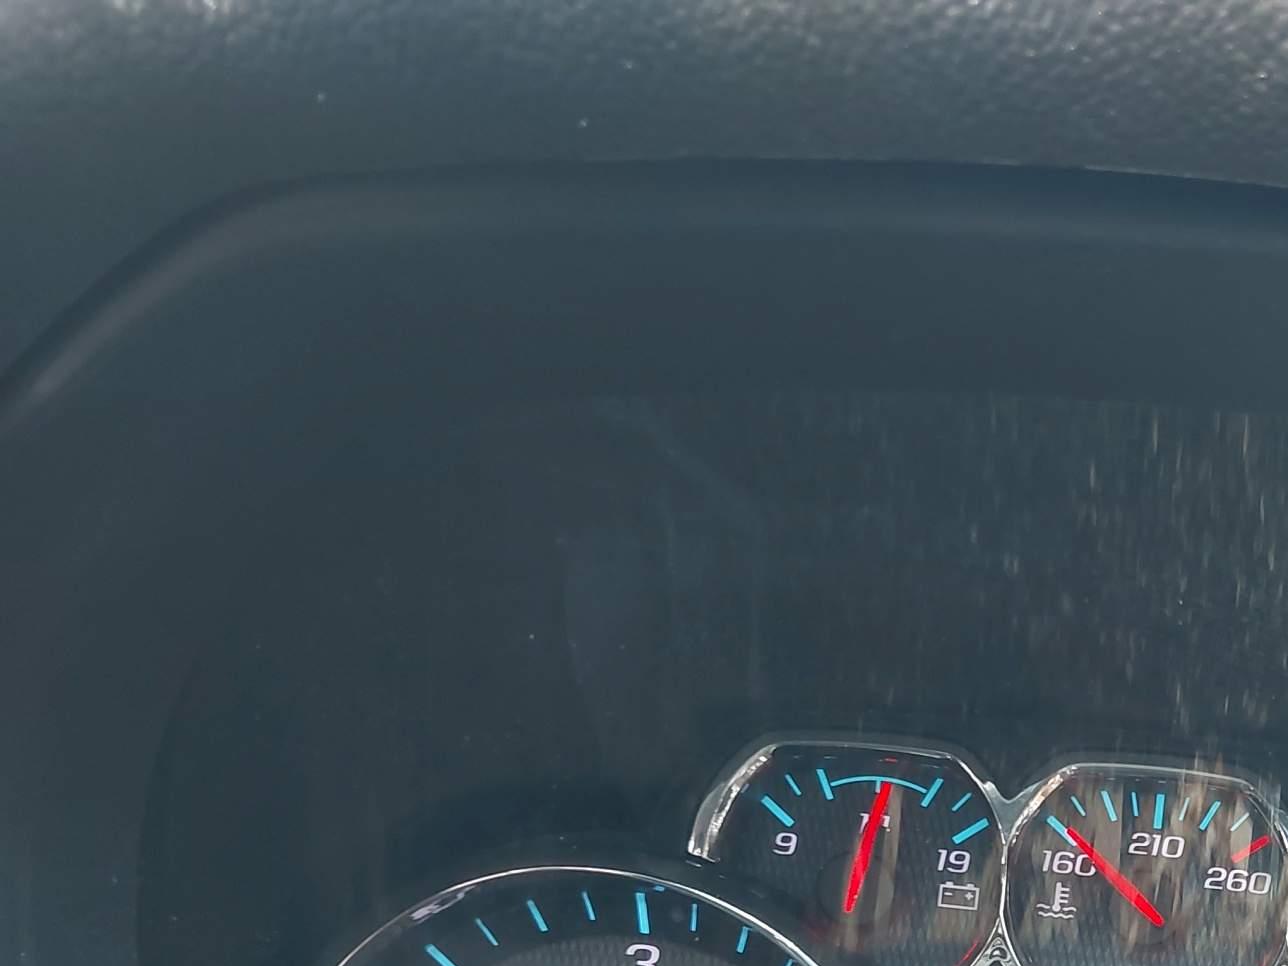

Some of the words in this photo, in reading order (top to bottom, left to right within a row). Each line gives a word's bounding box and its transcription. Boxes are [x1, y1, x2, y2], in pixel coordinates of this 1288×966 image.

[772, 832, 797, 855] 9
[1128, 832, 1184, 858] 210
[936, 849, 970, 873] 19
[1041, 850, 1096, 878] 160
[1203, 866, 1271, 895] 260
